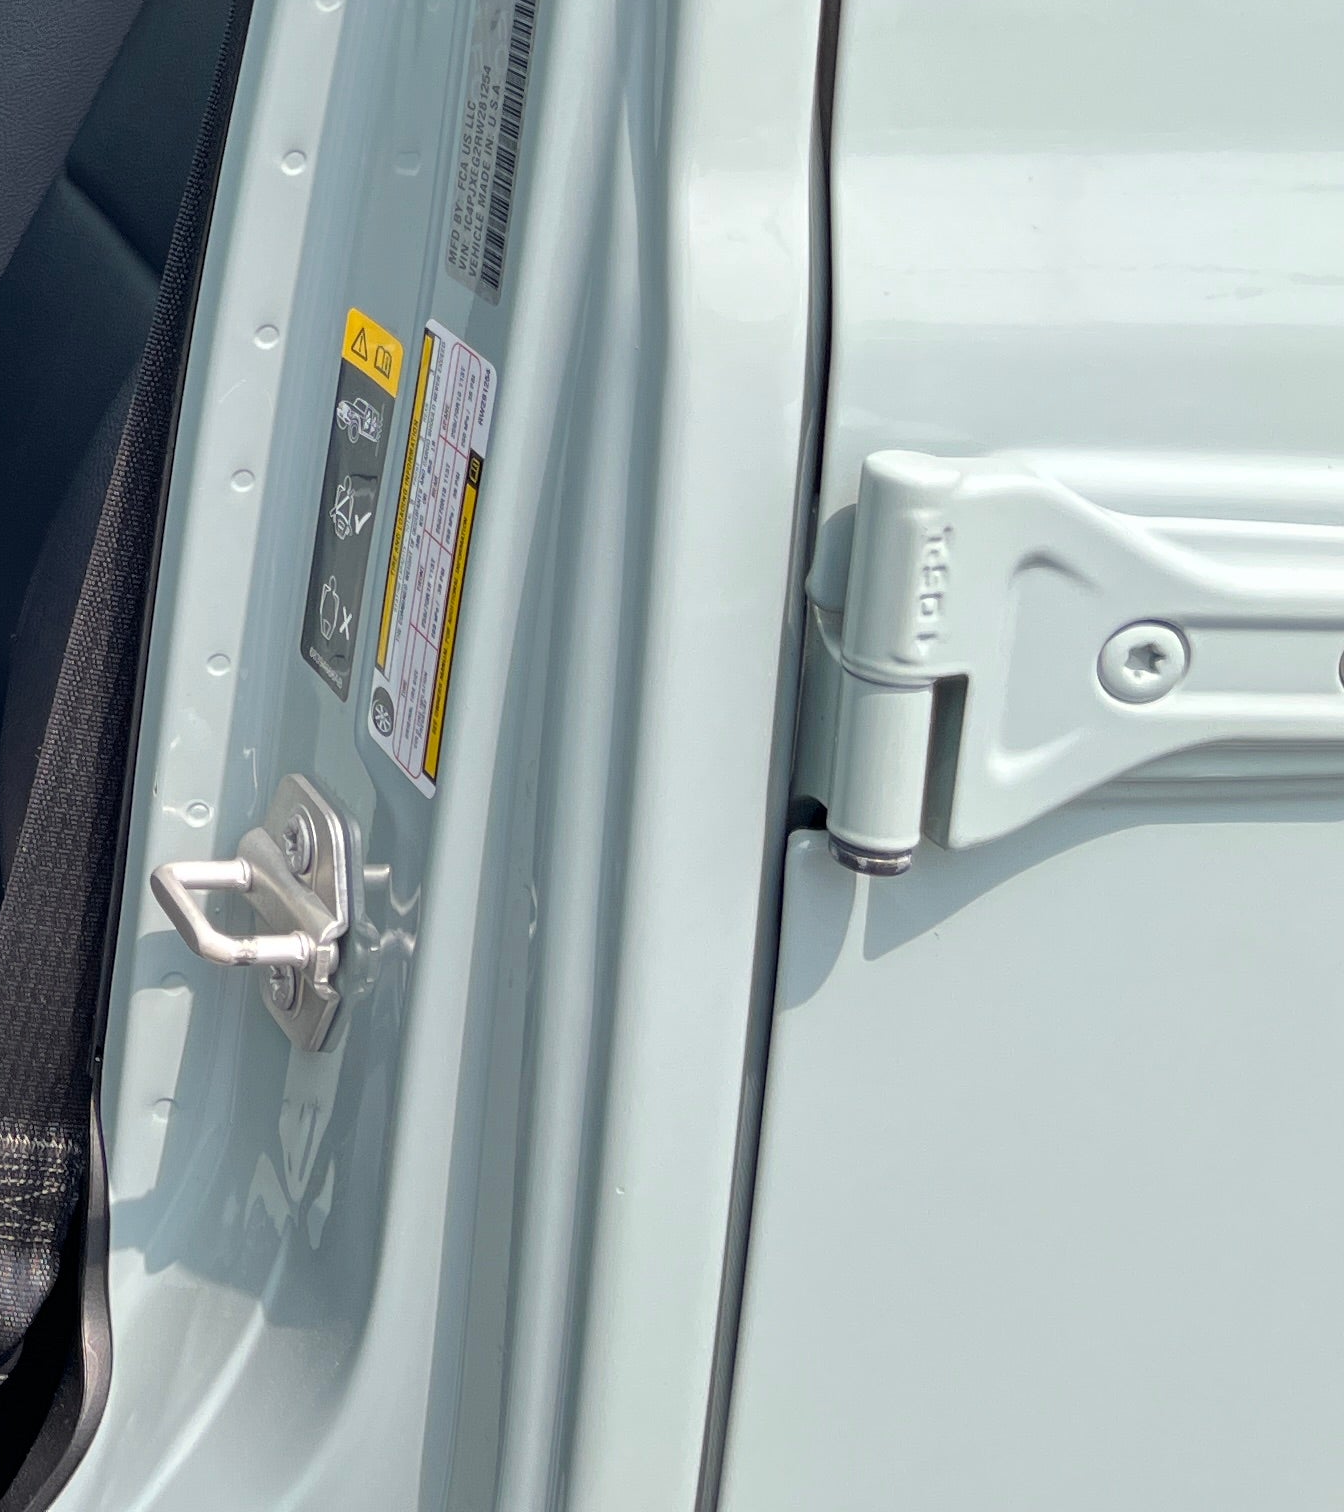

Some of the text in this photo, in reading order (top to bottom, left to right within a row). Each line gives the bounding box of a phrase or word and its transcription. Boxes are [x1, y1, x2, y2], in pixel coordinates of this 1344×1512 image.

[461, 132, 472, 155] US
[464, 99, 476, 129] LLC
[456, 159, 469, 191] FCA
[447, 228, 460, 265] MFD
[468, 212, 484, 279] VEHICLE
[477, 160, 491, 208] MADE
[397, 487, 407, 530] LOADING
[404, 418, 418, 486] INFORMATION
[404, 550, 412, 582] WEIGHT
[427, 403, 435, 437] SHOULD
[437, 340, 445, 374] EXCEED
[447, 576, 458, 625] ADDITIONAL
[455, 515, 467, 575] INFORMATION
